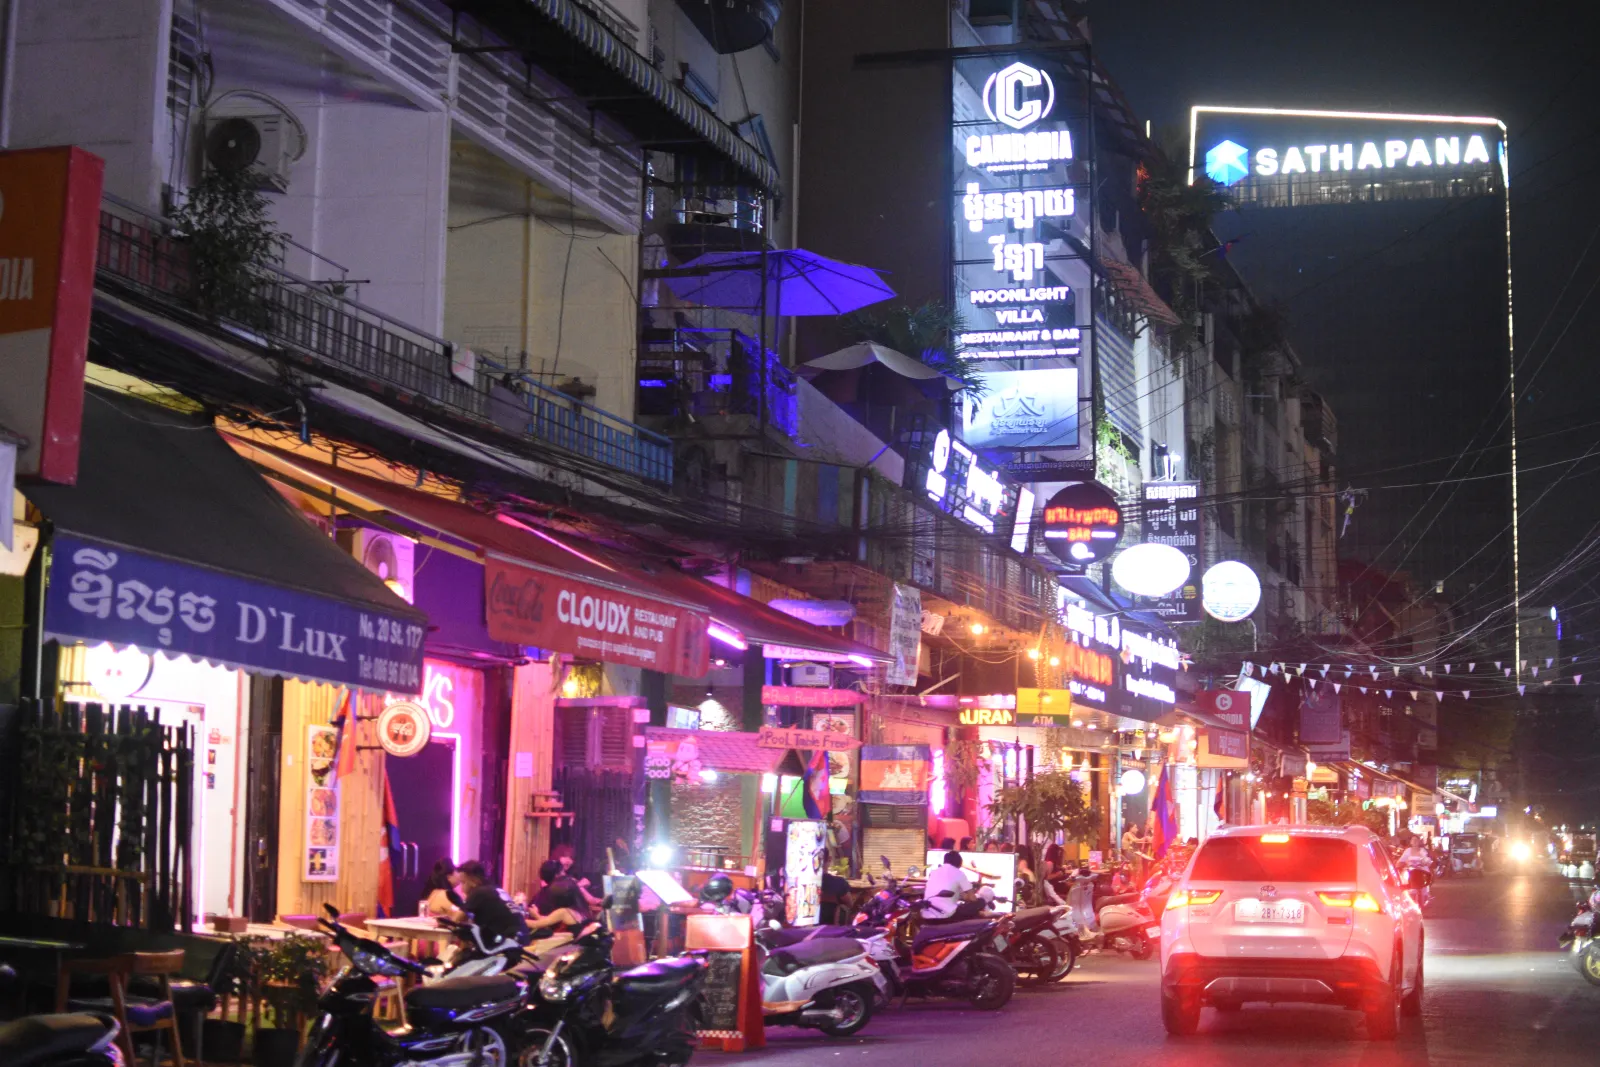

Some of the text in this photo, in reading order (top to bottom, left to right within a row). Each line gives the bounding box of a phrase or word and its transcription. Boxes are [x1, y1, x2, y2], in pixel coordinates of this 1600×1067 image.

[1255, 135, 1490, 176] SATHAPANA
[970, 286, 1069, 303] MOONLIGHT
[996, 308, 1044, 323] VILLA
[960, 330, 1040, 344] RESTAURANT
[1053, 328, 1080, 340] BAR
[1067, 527, 1092, 542] BAR
[557, 589, 678, 637] CLOUDX RESTAURANT
[649, 628, 664, 643] PUB
[1032, 716, 1054, 726] ATM
